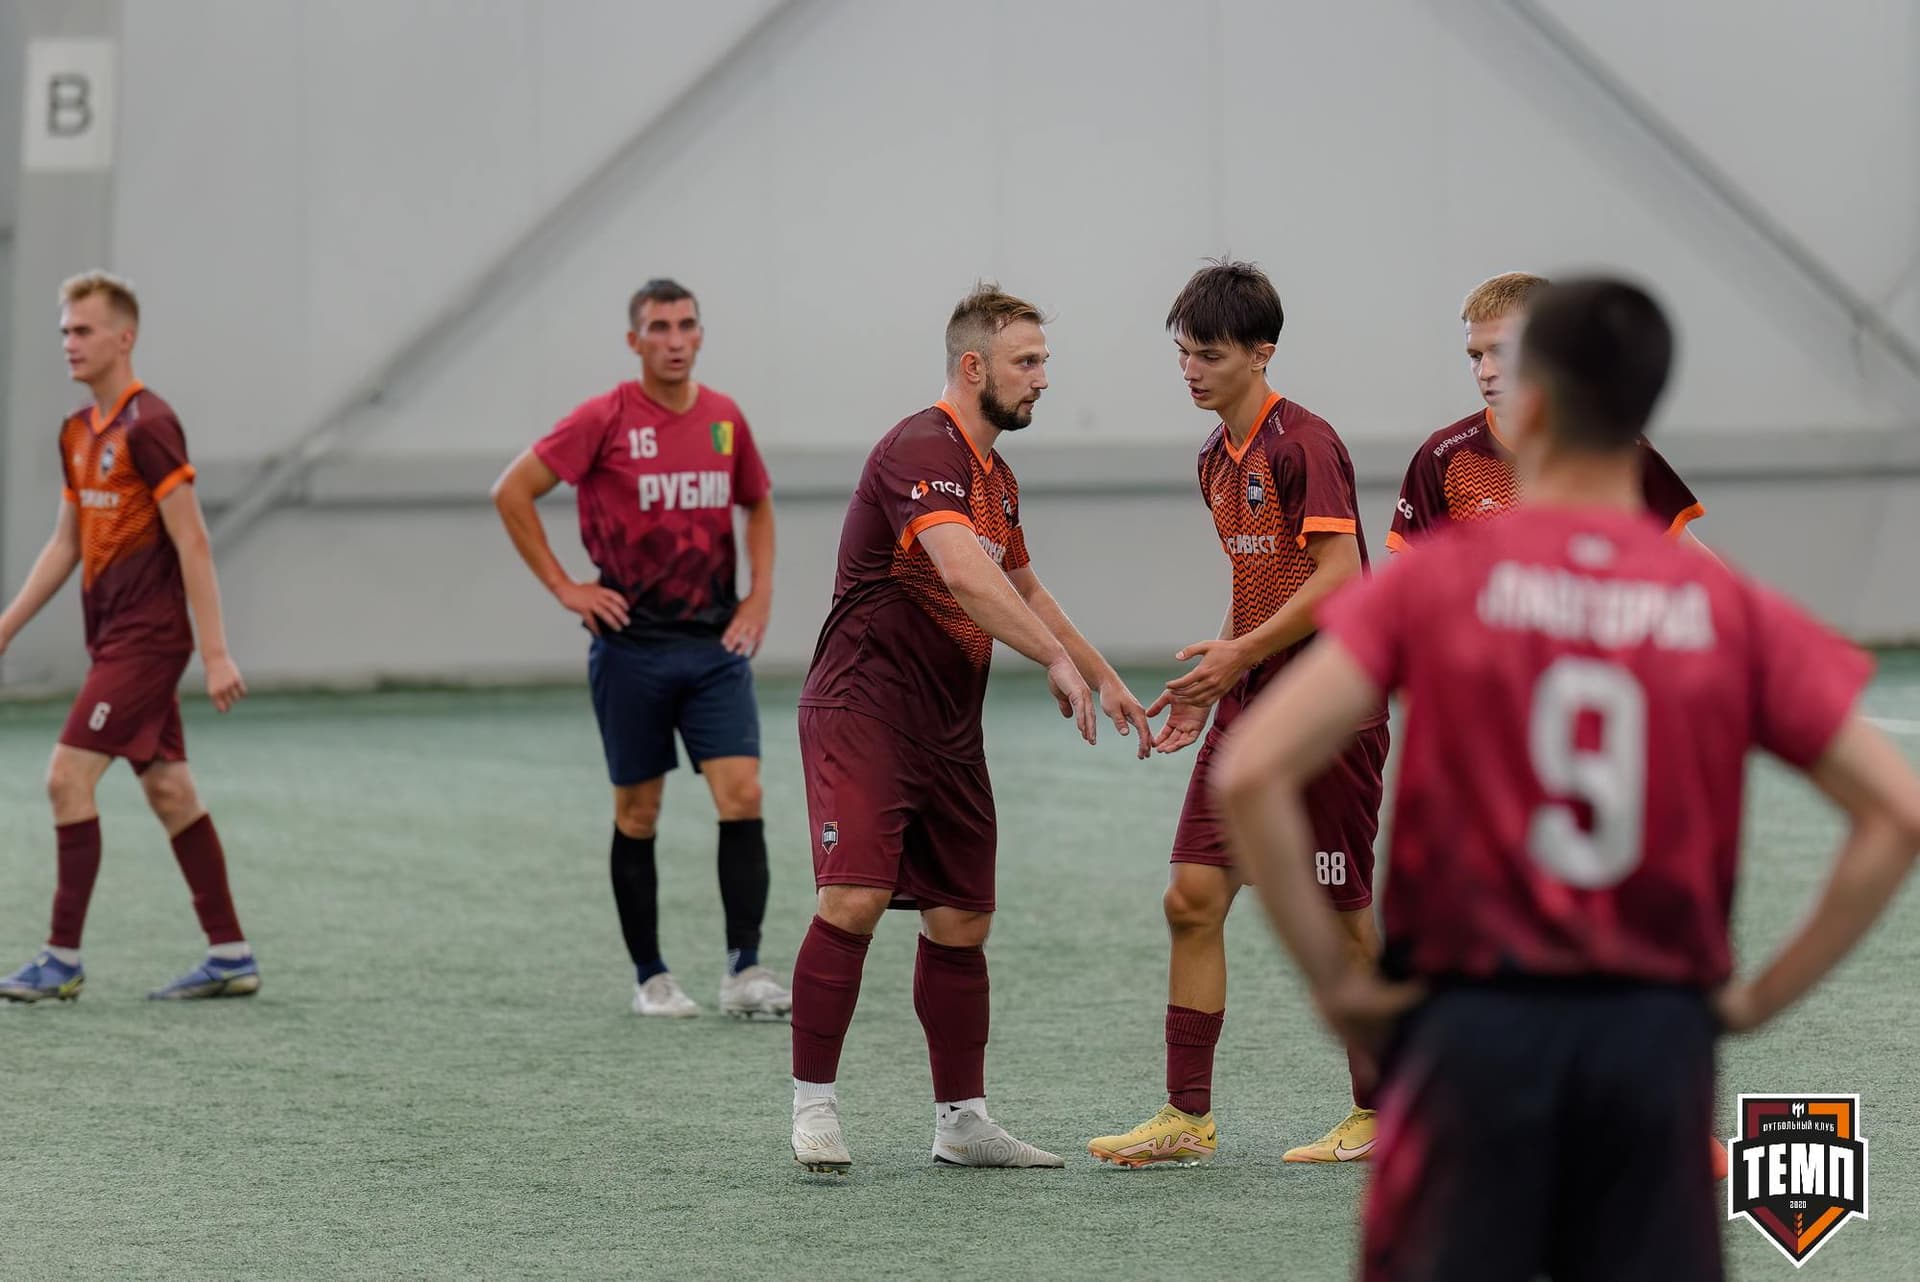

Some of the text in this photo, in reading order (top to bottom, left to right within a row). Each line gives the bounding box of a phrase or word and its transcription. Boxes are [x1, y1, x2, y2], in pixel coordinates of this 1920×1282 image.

[47, 73, 94, 137] B
[627, 426, 658, 460] 16
[931, 480, 966, 498] ПСБ
[88, 701, 111, 731] 6
[1528, 656, 1648, 889] 9
[1315, 851, 1346, 885] 88
